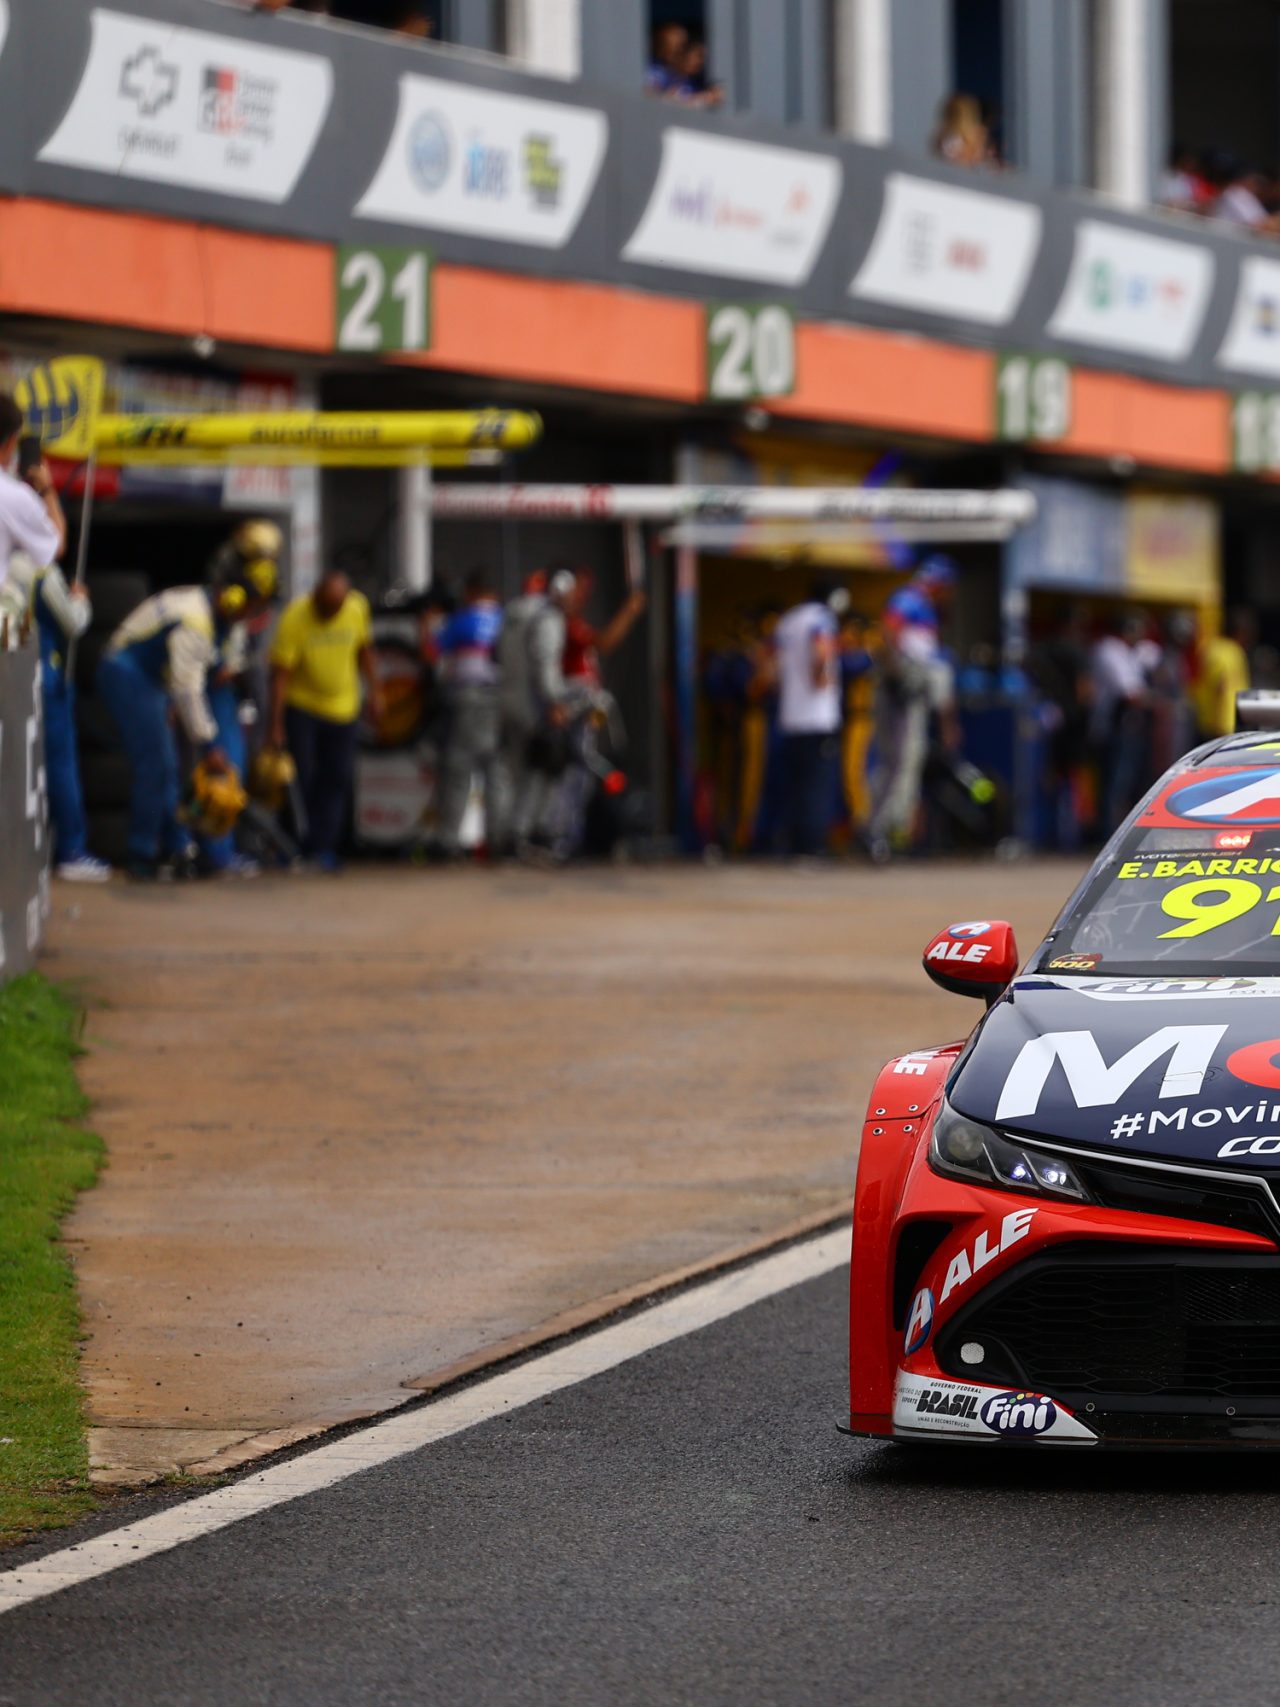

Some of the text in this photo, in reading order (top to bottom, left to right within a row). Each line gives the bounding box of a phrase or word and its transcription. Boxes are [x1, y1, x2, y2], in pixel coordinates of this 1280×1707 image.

[339, 251, 428, 352] 21
[710, 305, 795, 399] 20
[998, 356, 1071, 441] 19
[927, 941, 992, 964] ALE
[939, 1207, 1039, 1305] ALE
[916, 1389, 979, 1420] BRASIL
[934, 1419, 970, 1428] RECONSTRUÇÃO
[986, 1396, 1053, 1430] Fini
